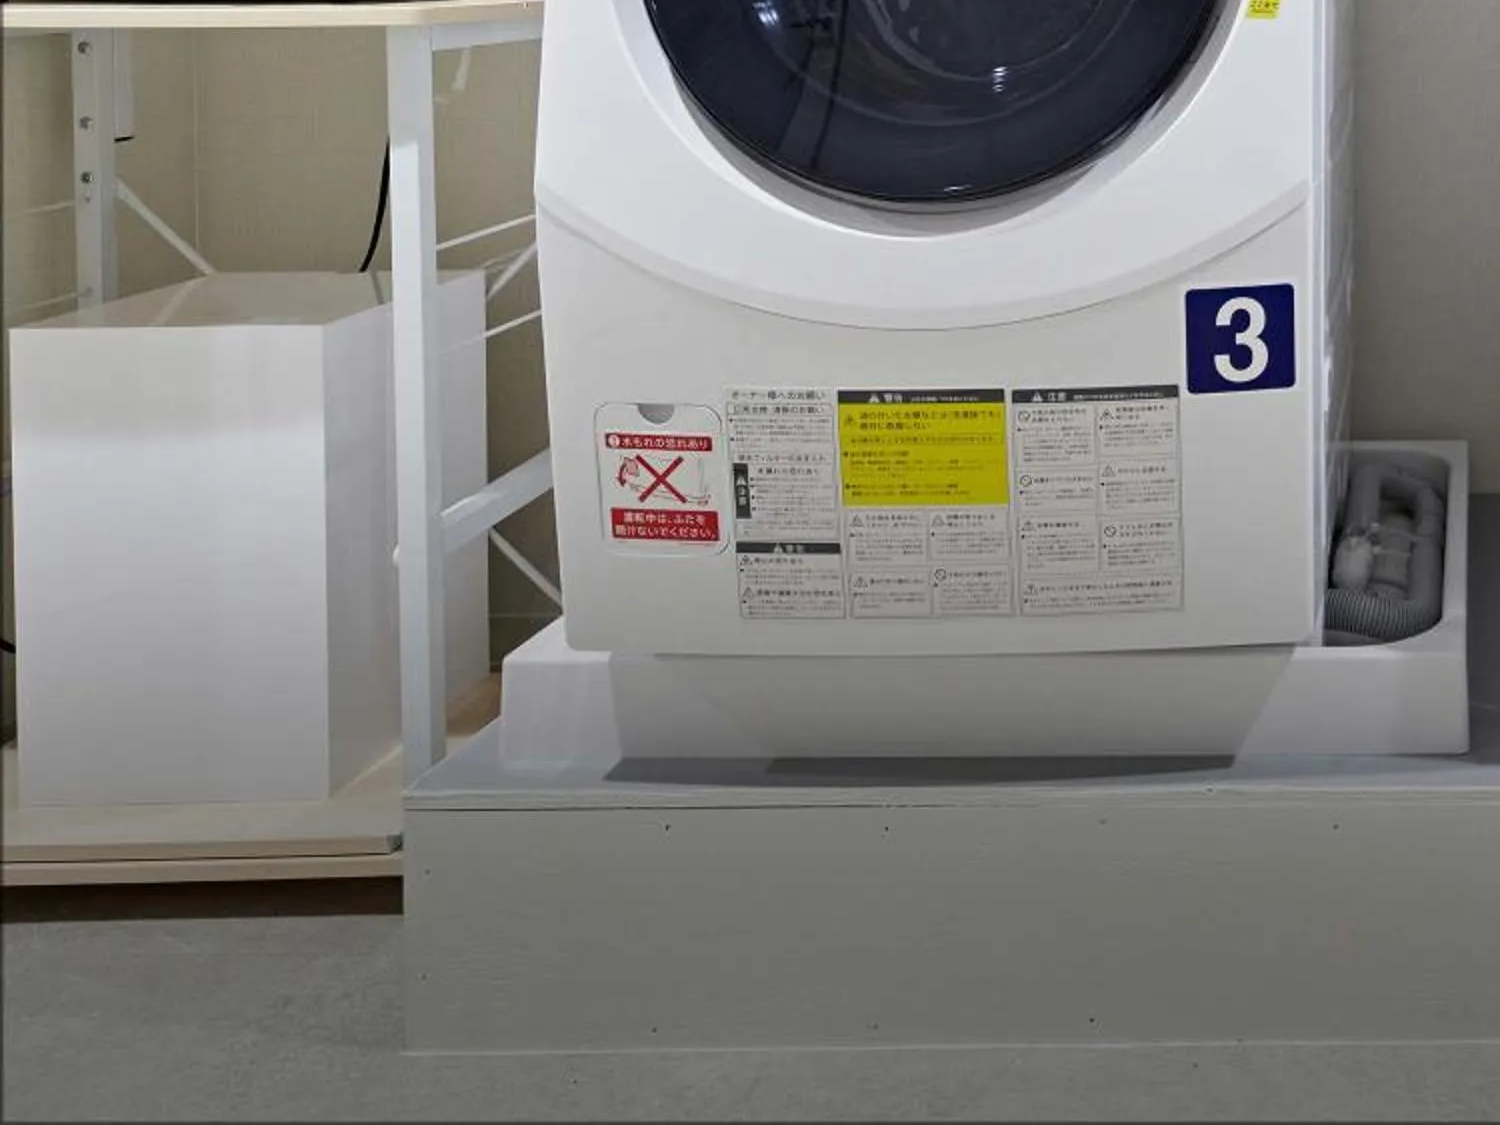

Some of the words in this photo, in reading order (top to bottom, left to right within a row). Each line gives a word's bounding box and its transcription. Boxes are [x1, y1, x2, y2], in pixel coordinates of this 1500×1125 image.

[1214, 296, 1269, 383] 3
[621, 437, 708, 450] 水もれの恐れあり
[614, 525, 716, 539] 開けないでください。
